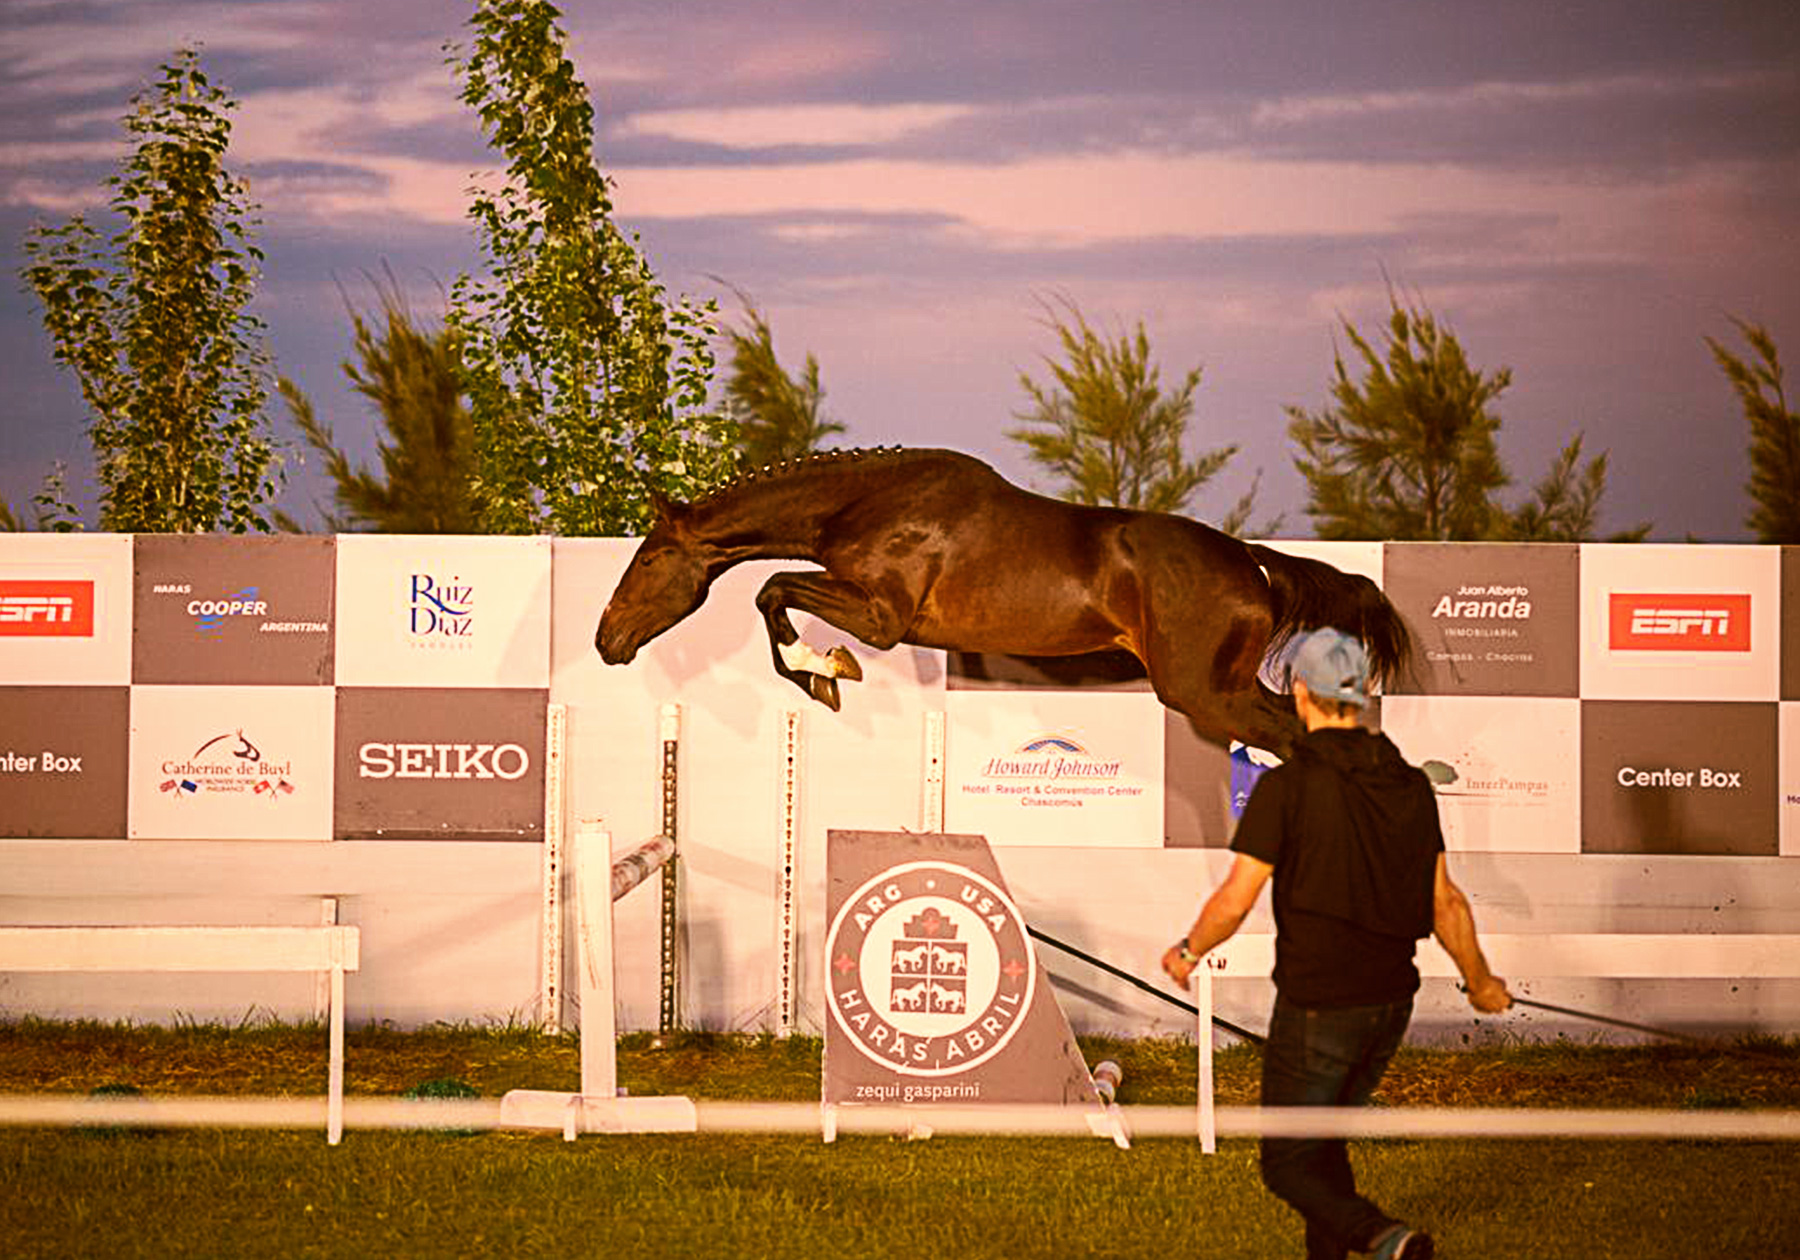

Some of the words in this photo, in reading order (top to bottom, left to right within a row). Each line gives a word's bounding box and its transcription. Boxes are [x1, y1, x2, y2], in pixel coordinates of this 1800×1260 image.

[153, 585, 192, 594] HARAS
[411, 574, 473, 615] Ruiz
[1457, 586, 1486, 596] Juan
[1487, 586, 1528, 596] Alberto
[0, 596, 72, 622] SPN
[187, 600, 267, 616] COOPER
[1431, 595, 1531, 618] Aranda
[259, 622, 329, 632] ARGENTINA
[1631, 609, 1730, 635] ESPN
[1445, 627, 1519, 638] INMOBILIARIA
[42, 752, 82, 772] Box
[161, 760, 233, 775] Catherine
[236, 761, 255, 775] de
[359, 743, 529, 779] SEIKO
[984, 757, 1050, 776] Howard
[1049, 757, 1120, 780] Johnson
[1617, 767, 1694, 787] Center
[1699, 767, 1741, 788] Box
[995, 785, 1031, 796] Resort
[1034, 785, 1041, 795] &
[1044, 785, 1104, 797] Convention
[1107, 786, 1143, 797] Center
[853, 883, 902, 932] ARG
[961, 885, 1007, 933] USA
[946, 992, 1020, 1061] ABRIL
[856, 1082, 900, 1101] zequi
[904, 1082, 980, 1102] gasparini
